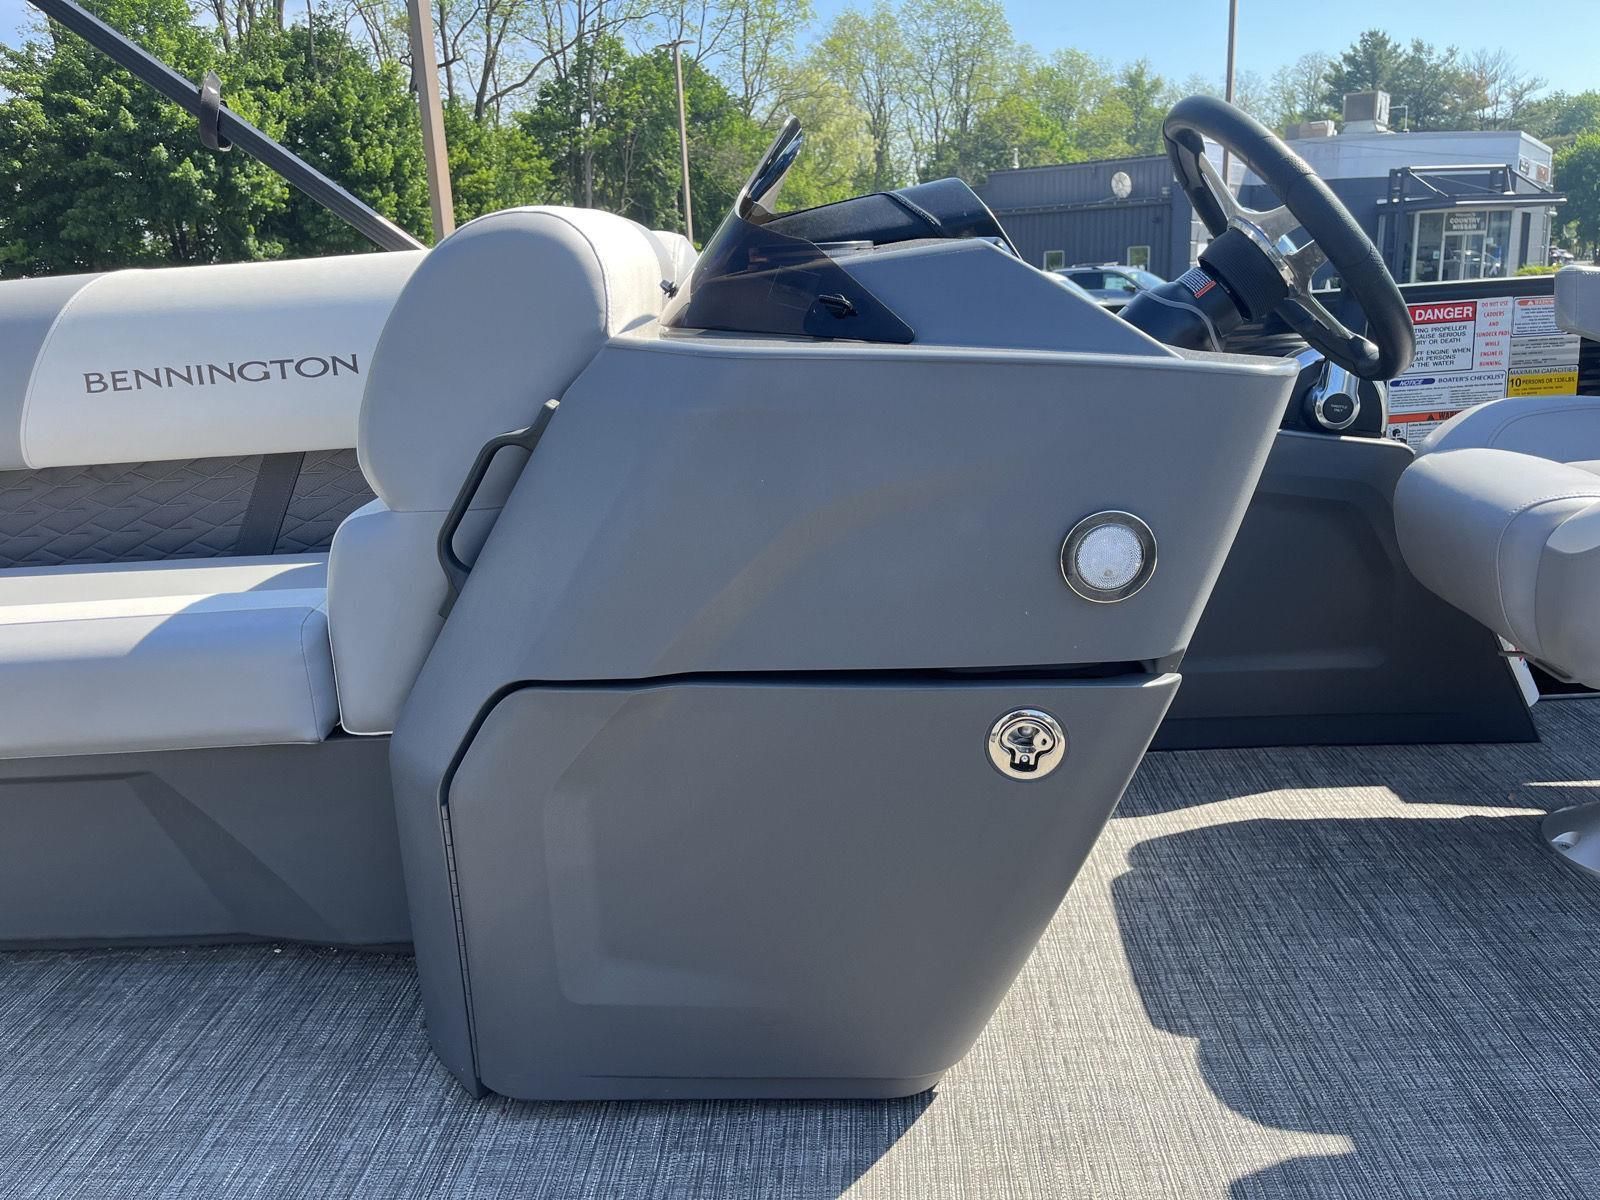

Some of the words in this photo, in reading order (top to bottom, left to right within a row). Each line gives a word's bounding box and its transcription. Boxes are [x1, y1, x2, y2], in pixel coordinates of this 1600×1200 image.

[1415, 306, 1473, 321] DANGER
[83, 354, 360, 394] BENNINGTON
[1510, 367, 1540, 375] MAXIMUM
[1542, 366, 1577, 374] CAPACITIES
[1470, 374, 1504, 382] CHECKLIST
[1510, 378, 1521, 388] 10
